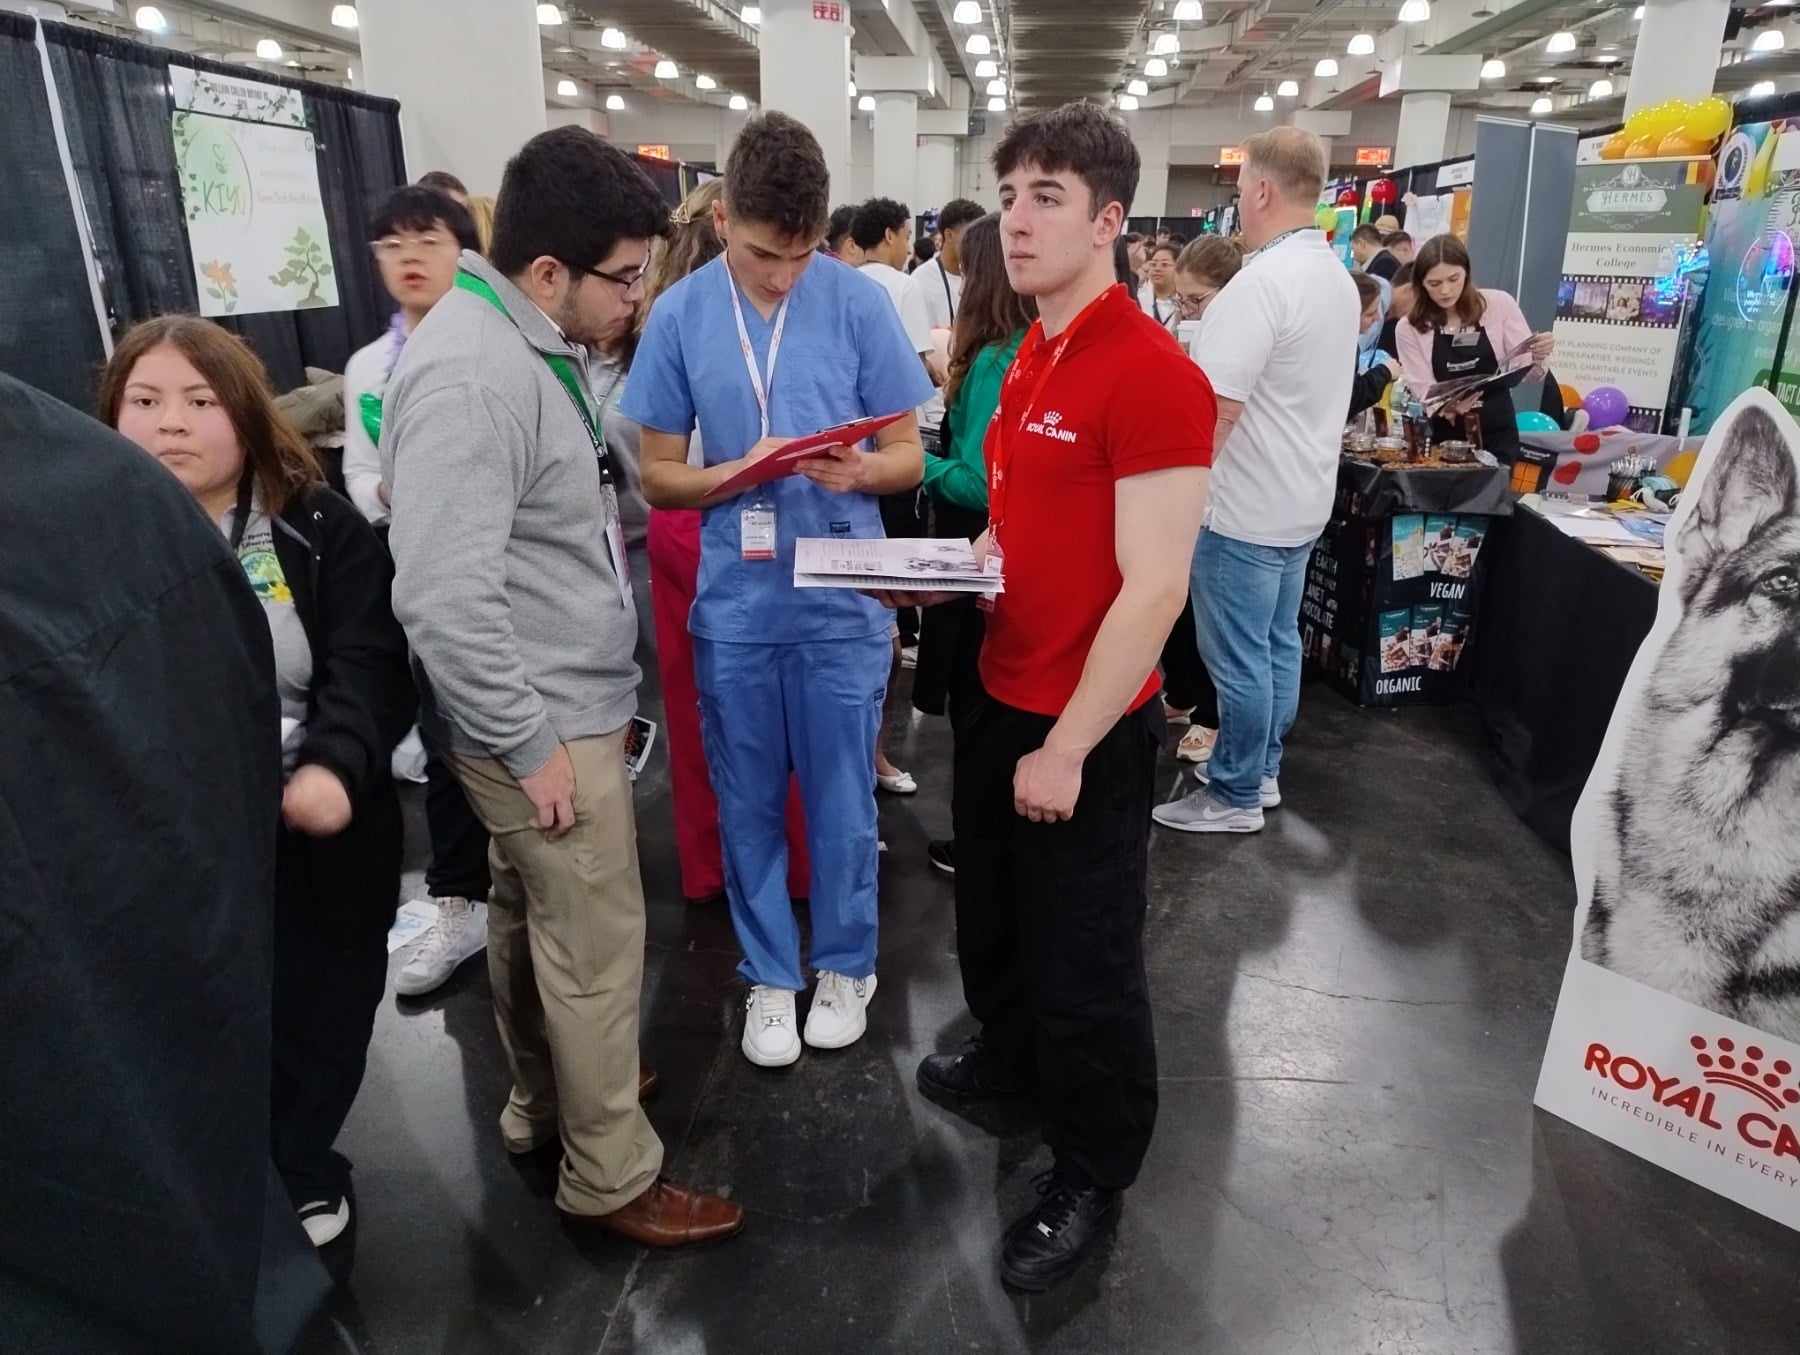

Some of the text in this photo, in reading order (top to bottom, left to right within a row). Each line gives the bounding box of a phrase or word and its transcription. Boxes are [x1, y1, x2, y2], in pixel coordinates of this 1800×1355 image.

[1601, 191, 1654, 205] HERMES
[1572, 242, 1665, 254] Hermes Economic
[1596, 259, 1637, 270] College
[1567, 341, 1608, 350] PLANNING
[1610, 344, 1648, 353] COMPANY
[1627, 367, 1659, 377] EVENTS
[1045, 427, 1077, 443] CANIN
[1430, 582, 1466, 599] VEGAN
[1376, 676, 1422, 695] ORGANIC
[1584, 1042, 1800, 1164] ROYAL CA
[1591, 1086, 1799, 1187] INCREDIBLE IN EVERY
